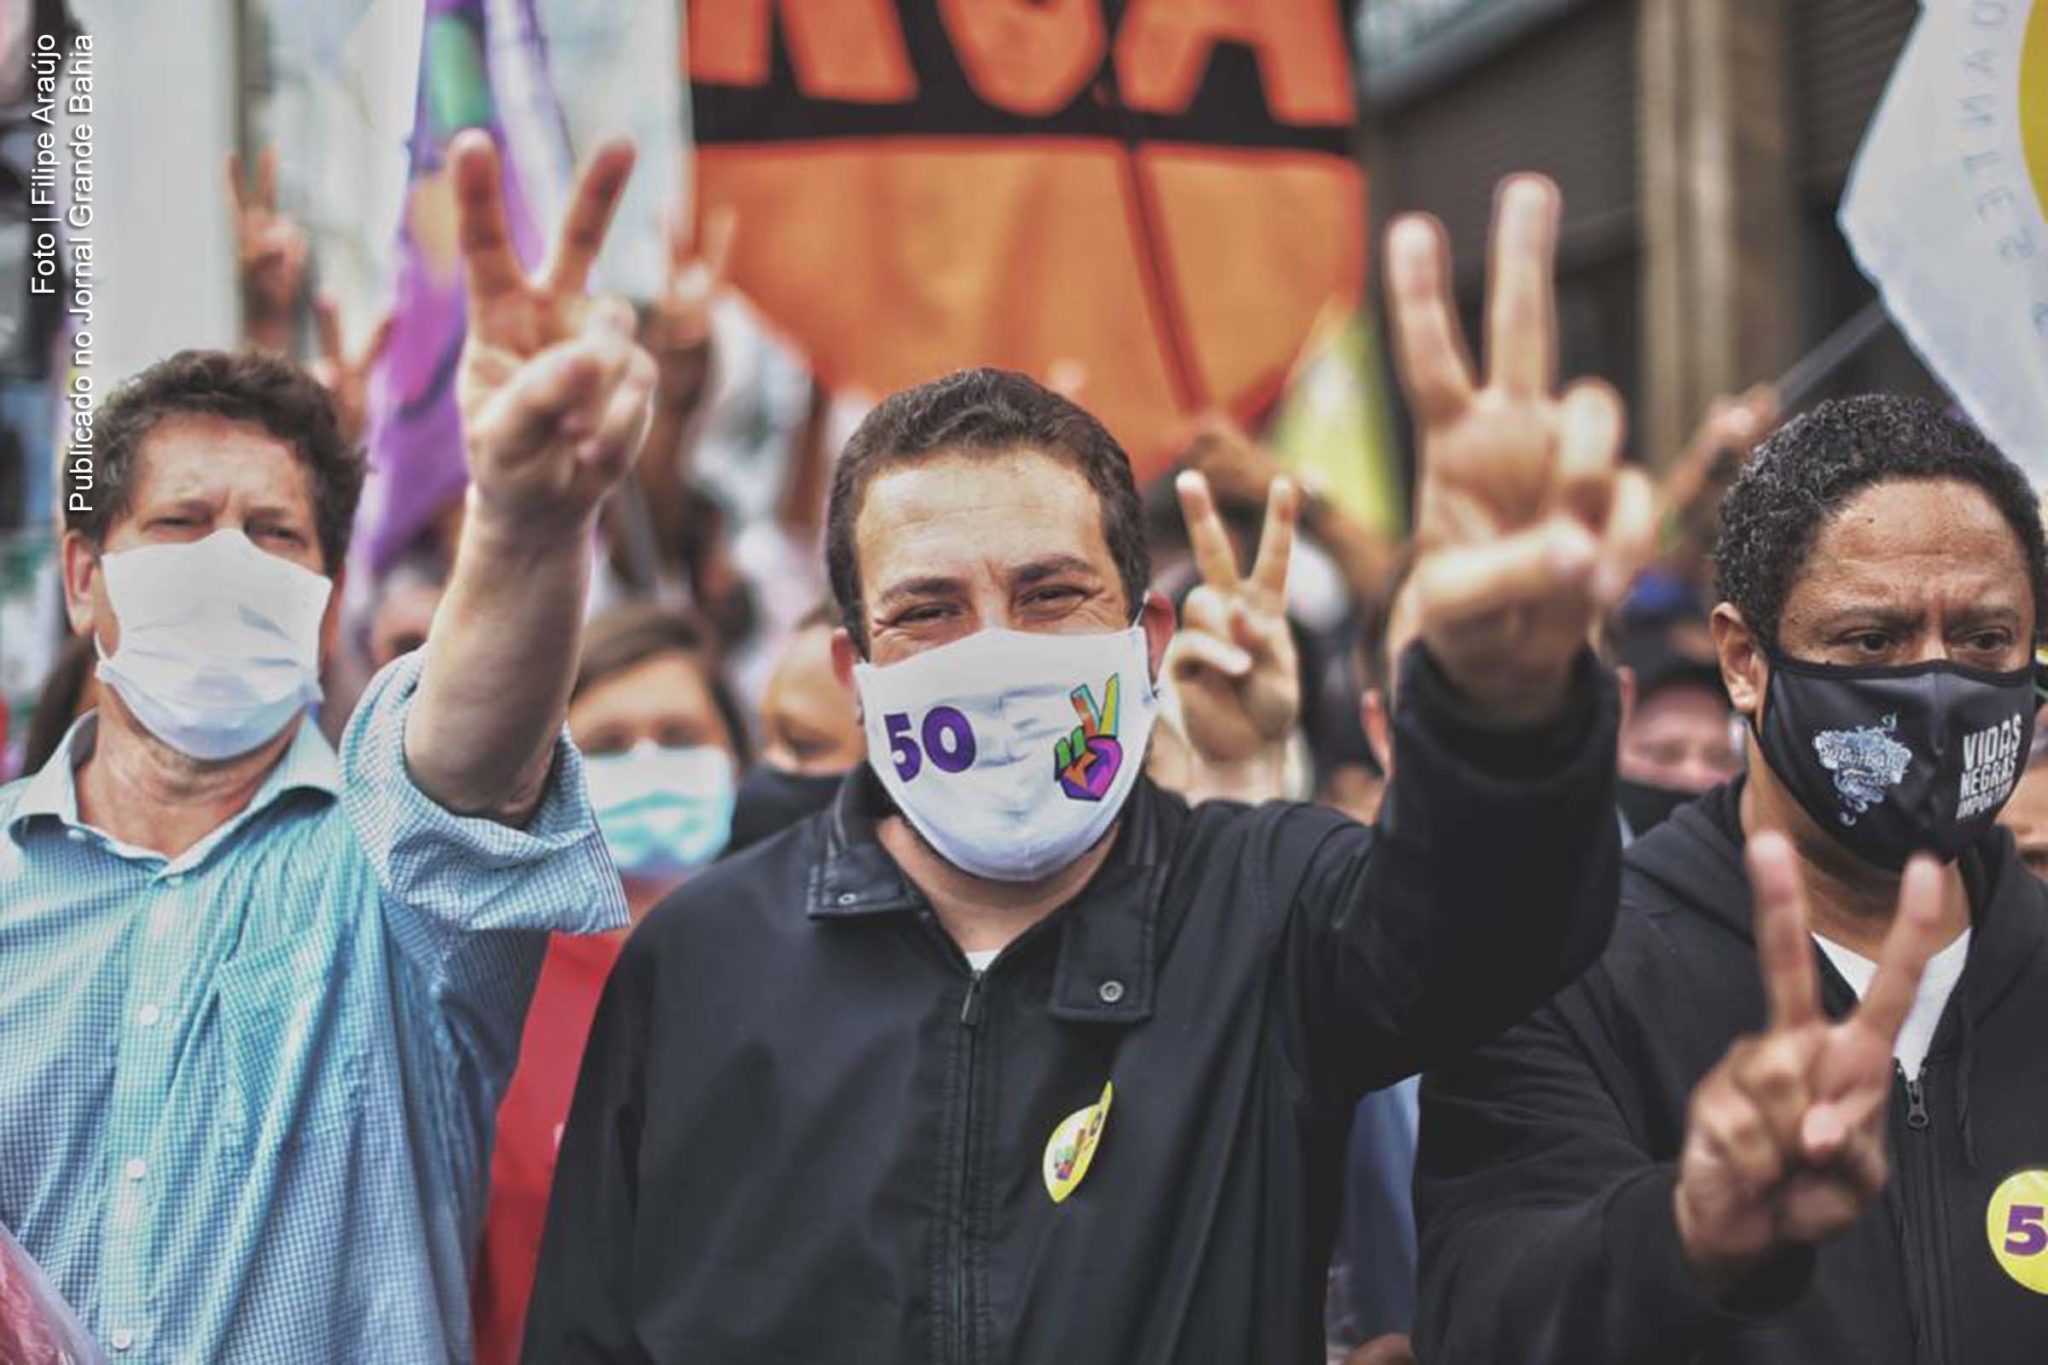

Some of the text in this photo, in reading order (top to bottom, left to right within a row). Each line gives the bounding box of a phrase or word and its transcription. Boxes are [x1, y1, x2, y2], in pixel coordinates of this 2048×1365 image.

[883, 706, 977, 784] 50
[1963, 713, 2022, 771] VIDAS
[1960, 757, 2016, 800] NEGRAS
